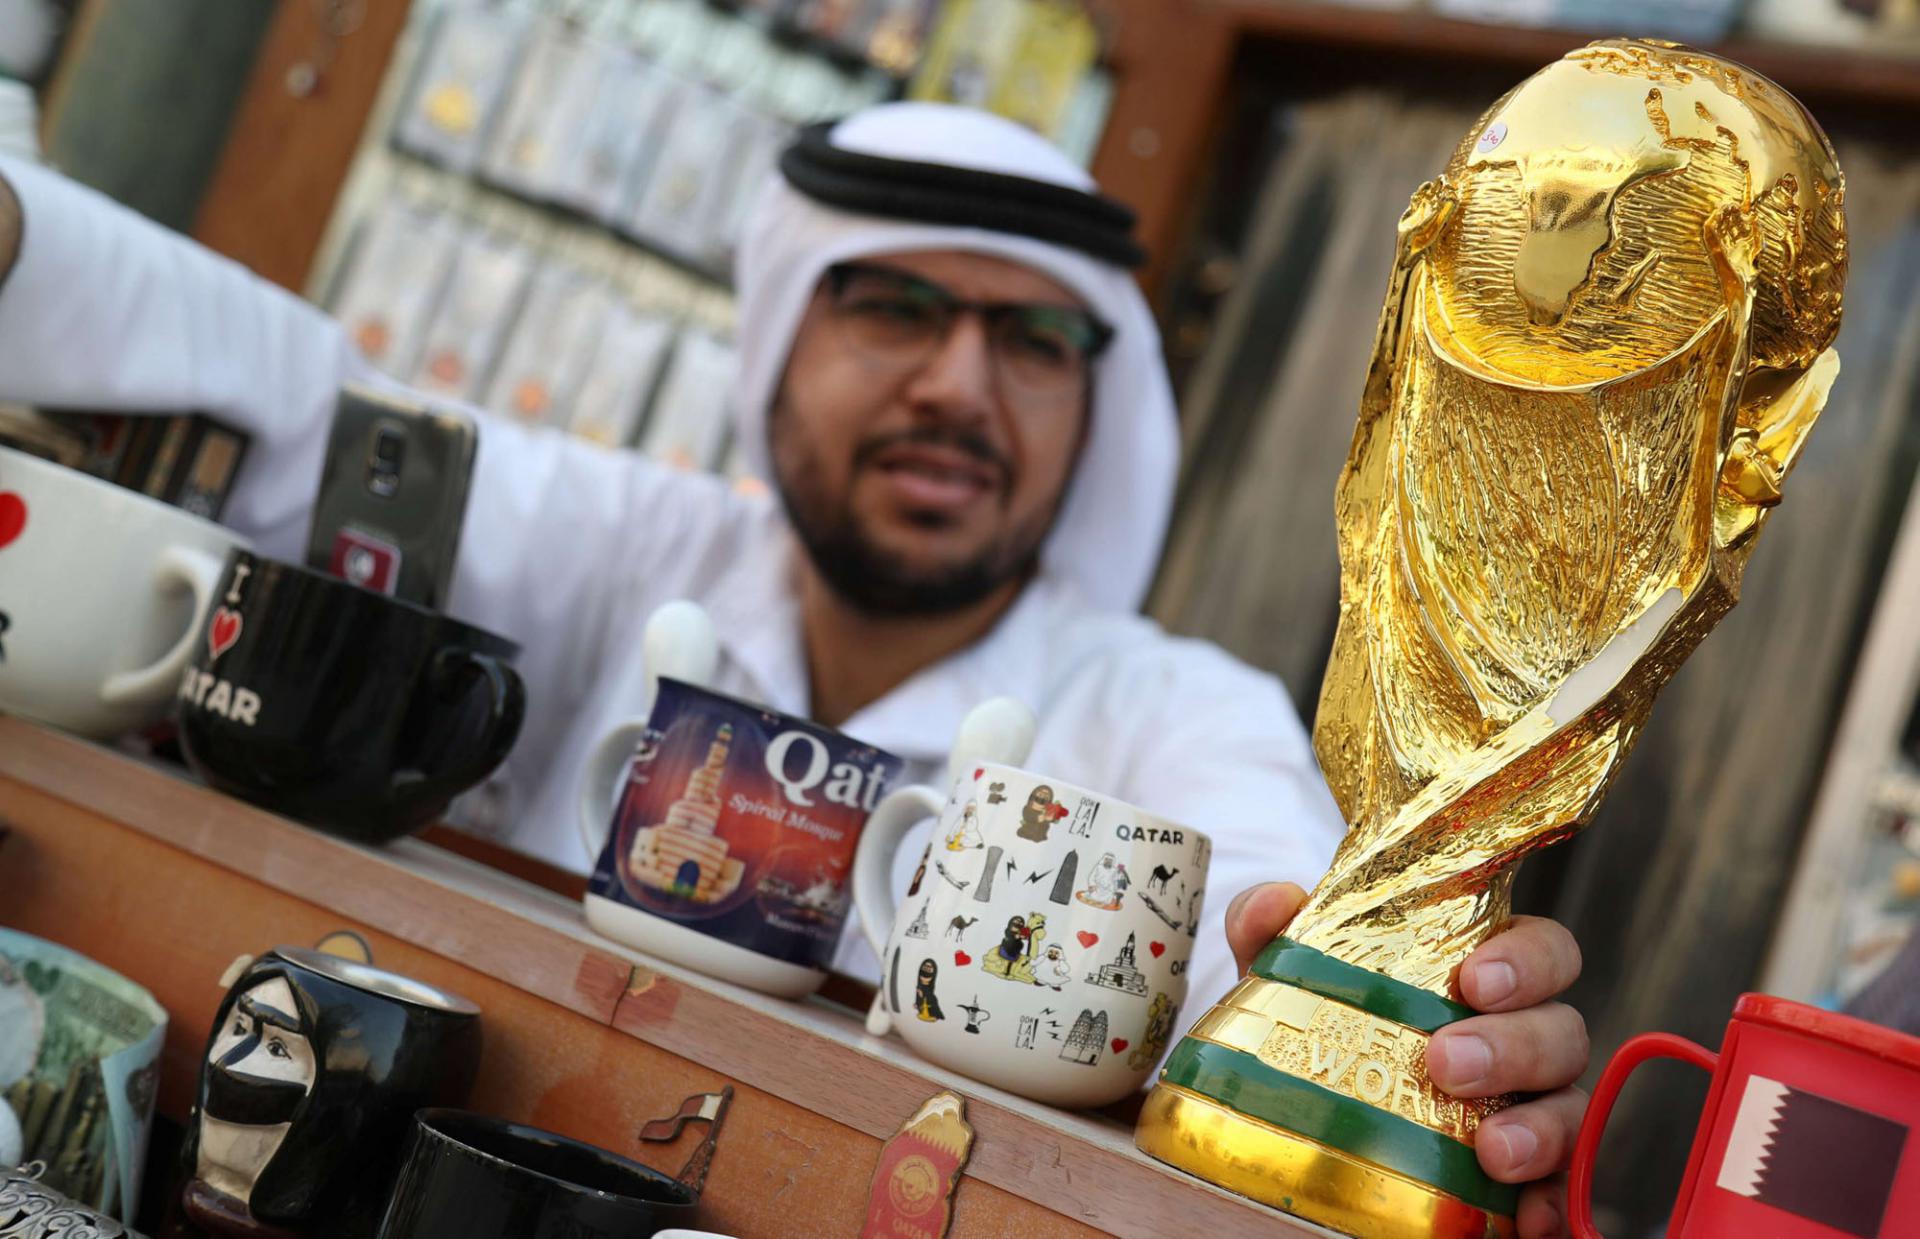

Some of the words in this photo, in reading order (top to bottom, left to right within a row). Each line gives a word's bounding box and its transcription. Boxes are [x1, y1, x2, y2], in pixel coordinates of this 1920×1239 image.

[225, 564, 250, 603] I
[179, 665, 262, 726] ATAR
[764, 730, 885, 813] Qat
[729, 793, 787, 822] Spiral
[1116, 825, 1184, 845] QATAR
